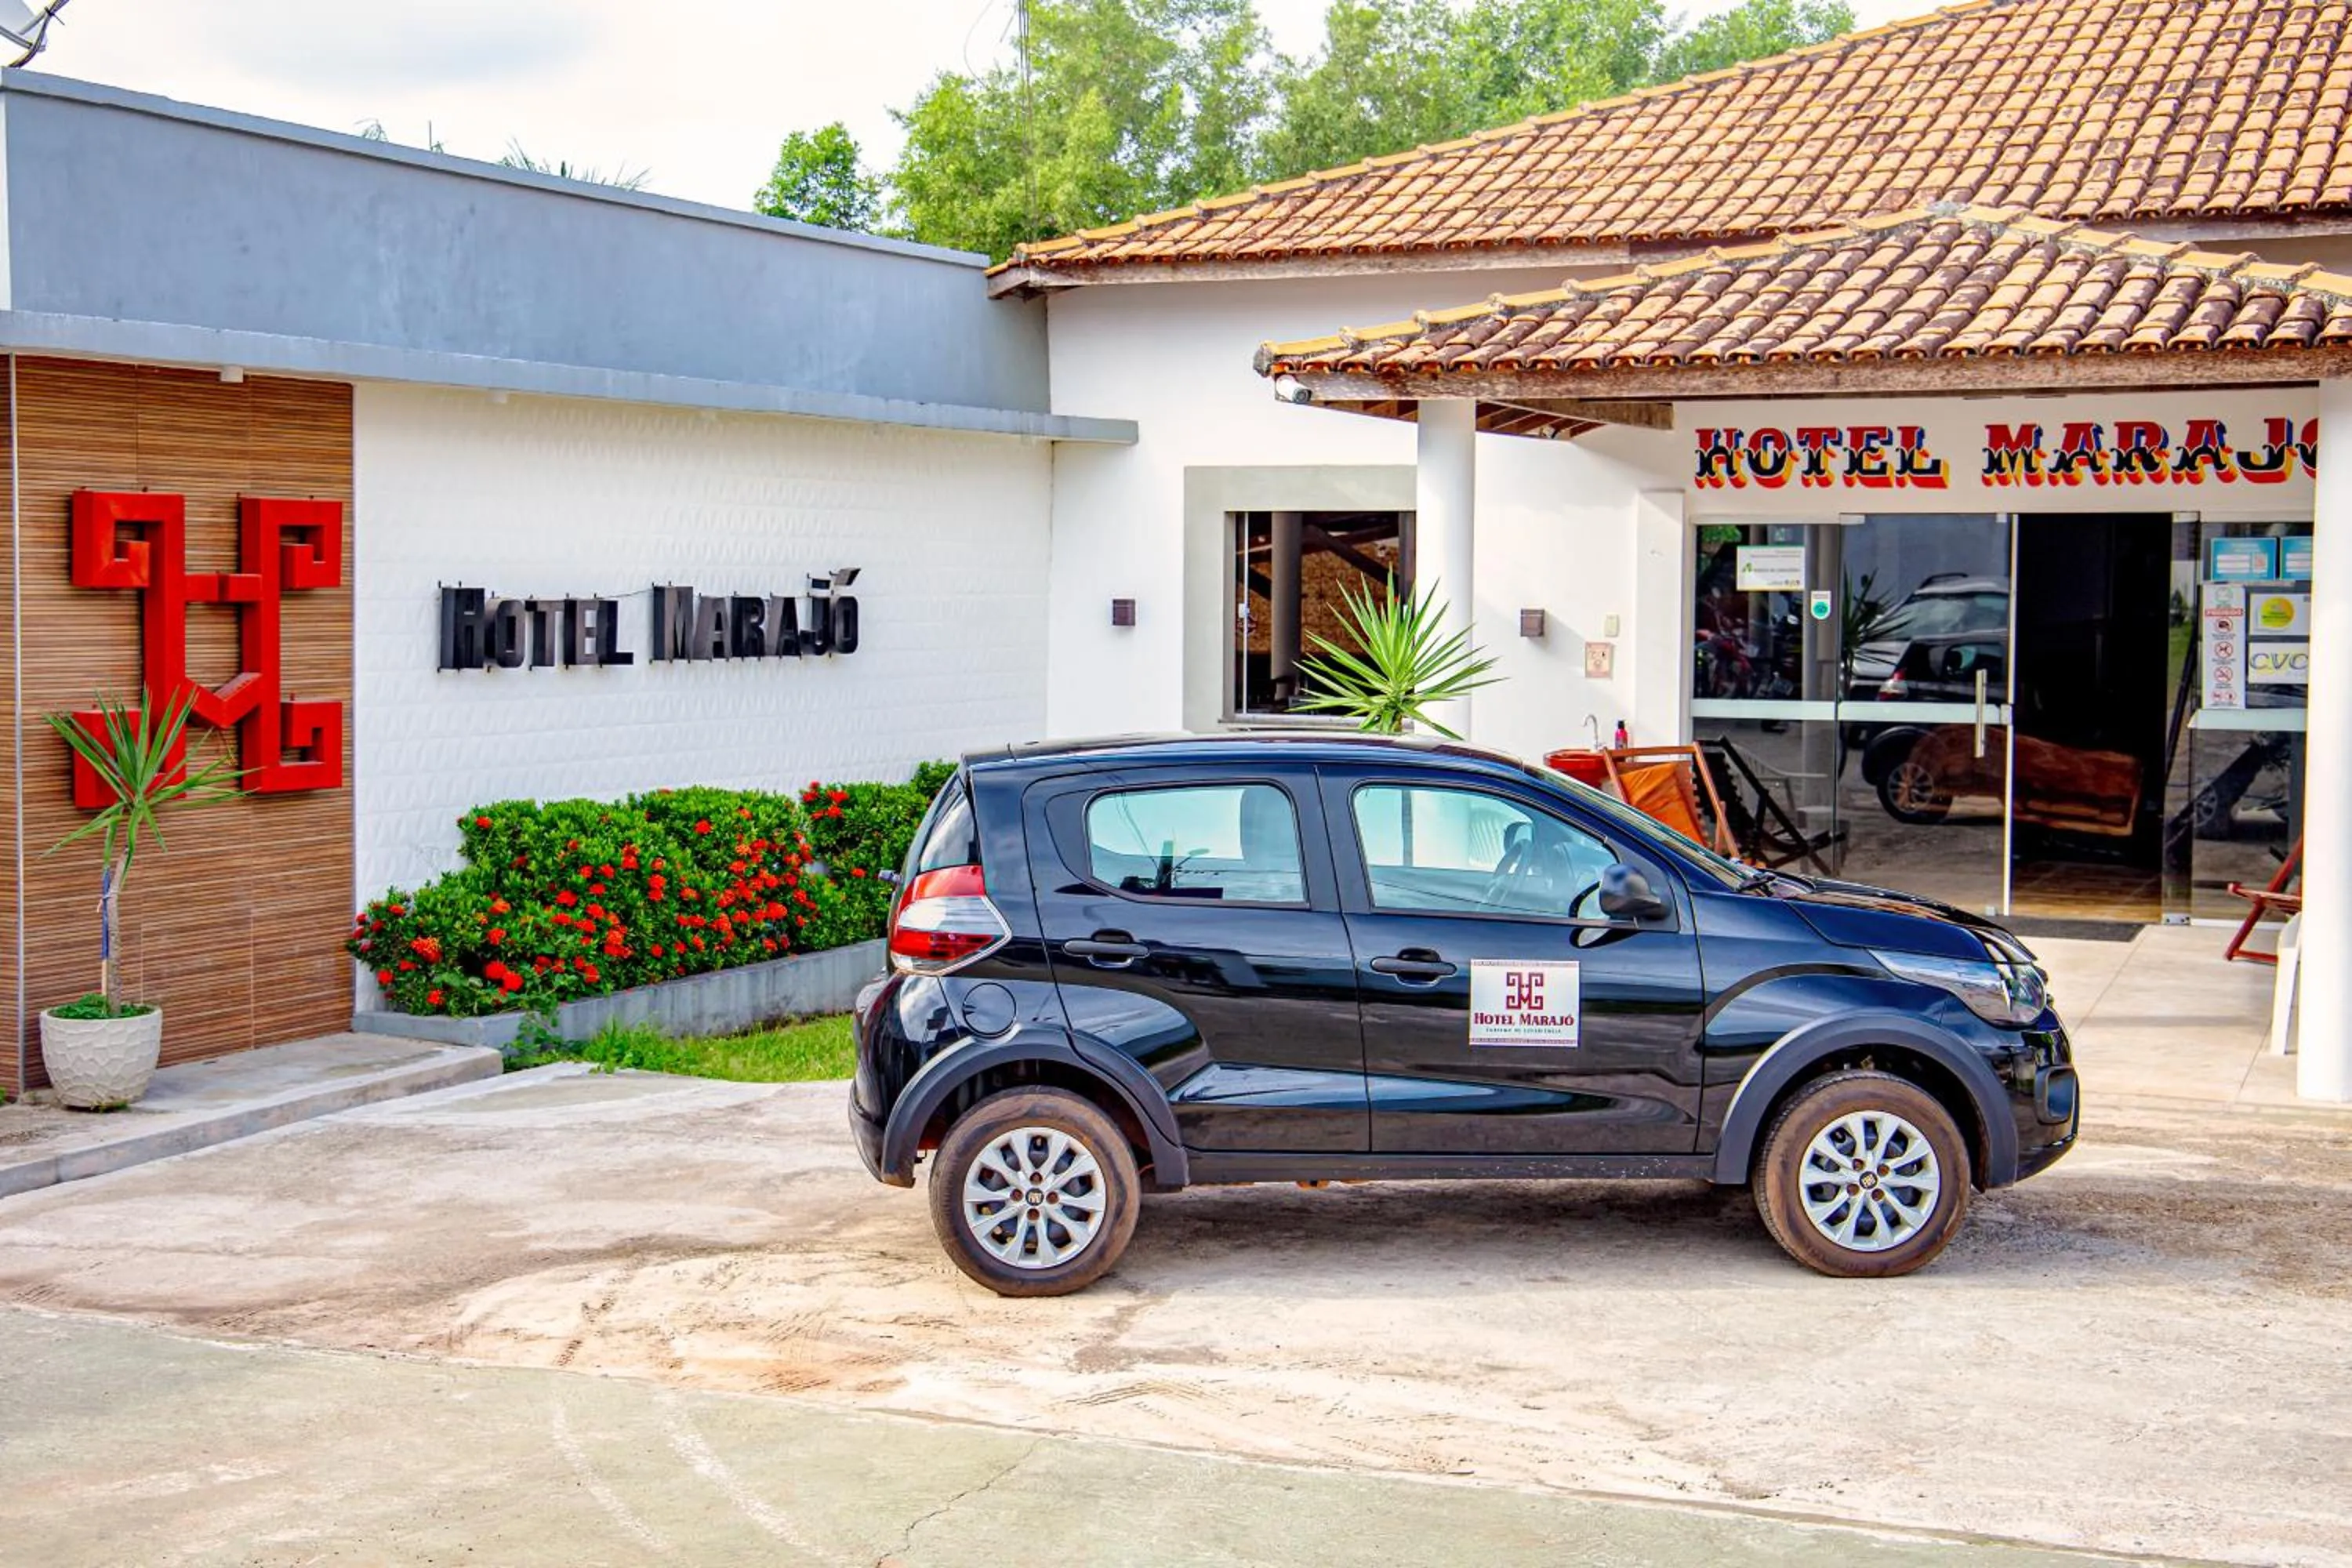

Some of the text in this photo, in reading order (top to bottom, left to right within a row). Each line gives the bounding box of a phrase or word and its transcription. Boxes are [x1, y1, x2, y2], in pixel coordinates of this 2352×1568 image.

[1694, 426, 1950, 489] HOTEL
[440, 567, 862, 669] HOTEL MARAJÓ
[1473, 1012, 1574, 1026] HOTEL MARAJÓ
